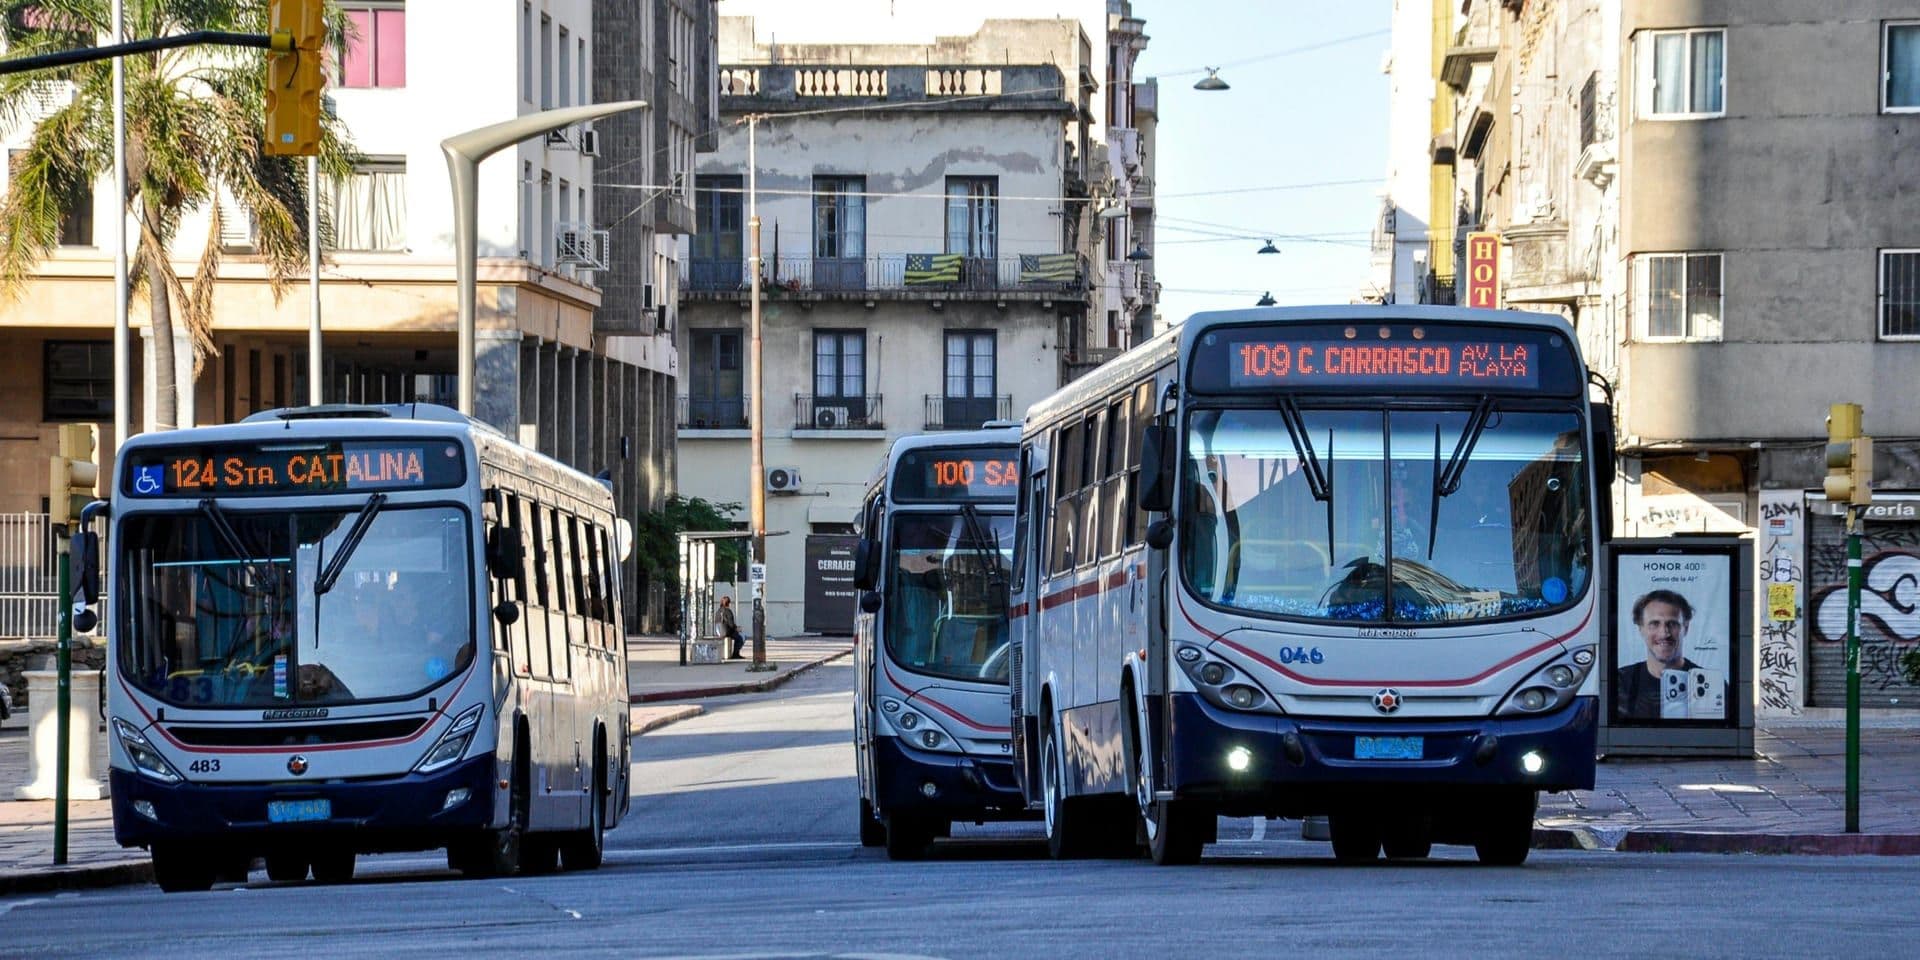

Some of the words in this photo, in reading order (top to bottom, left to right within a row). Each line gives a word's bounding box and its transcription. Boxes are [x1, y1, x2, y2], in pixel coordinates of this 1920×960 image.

[1474, 241, 1494, 305] HOT
[1240, 343, 1291, 377] 109
[1298, 346, 1320, 375] C.
[1325, 346, 1450, 375] CARRASCO
[1462, 345, 1493, 361] AV.
[1501, 344, 1527, 361] LA
[1459, 360, 1528, 377] PLAYA
[172, 455, 218, 488] 124
[286, 450, 424, 484] CATALINA
[933, 459, 975, 487] 100
[983, 459, 1019, 488] SA
[1643, 562, 1681, 571] HONOR
[1684, 562, 1700, 571] 400
[1670, 575, 1679, 583] de
[1680, 575, 1686, 583] la
[1280, 646, 1325, 664] 046
[189, 759, 221, 774] 483
